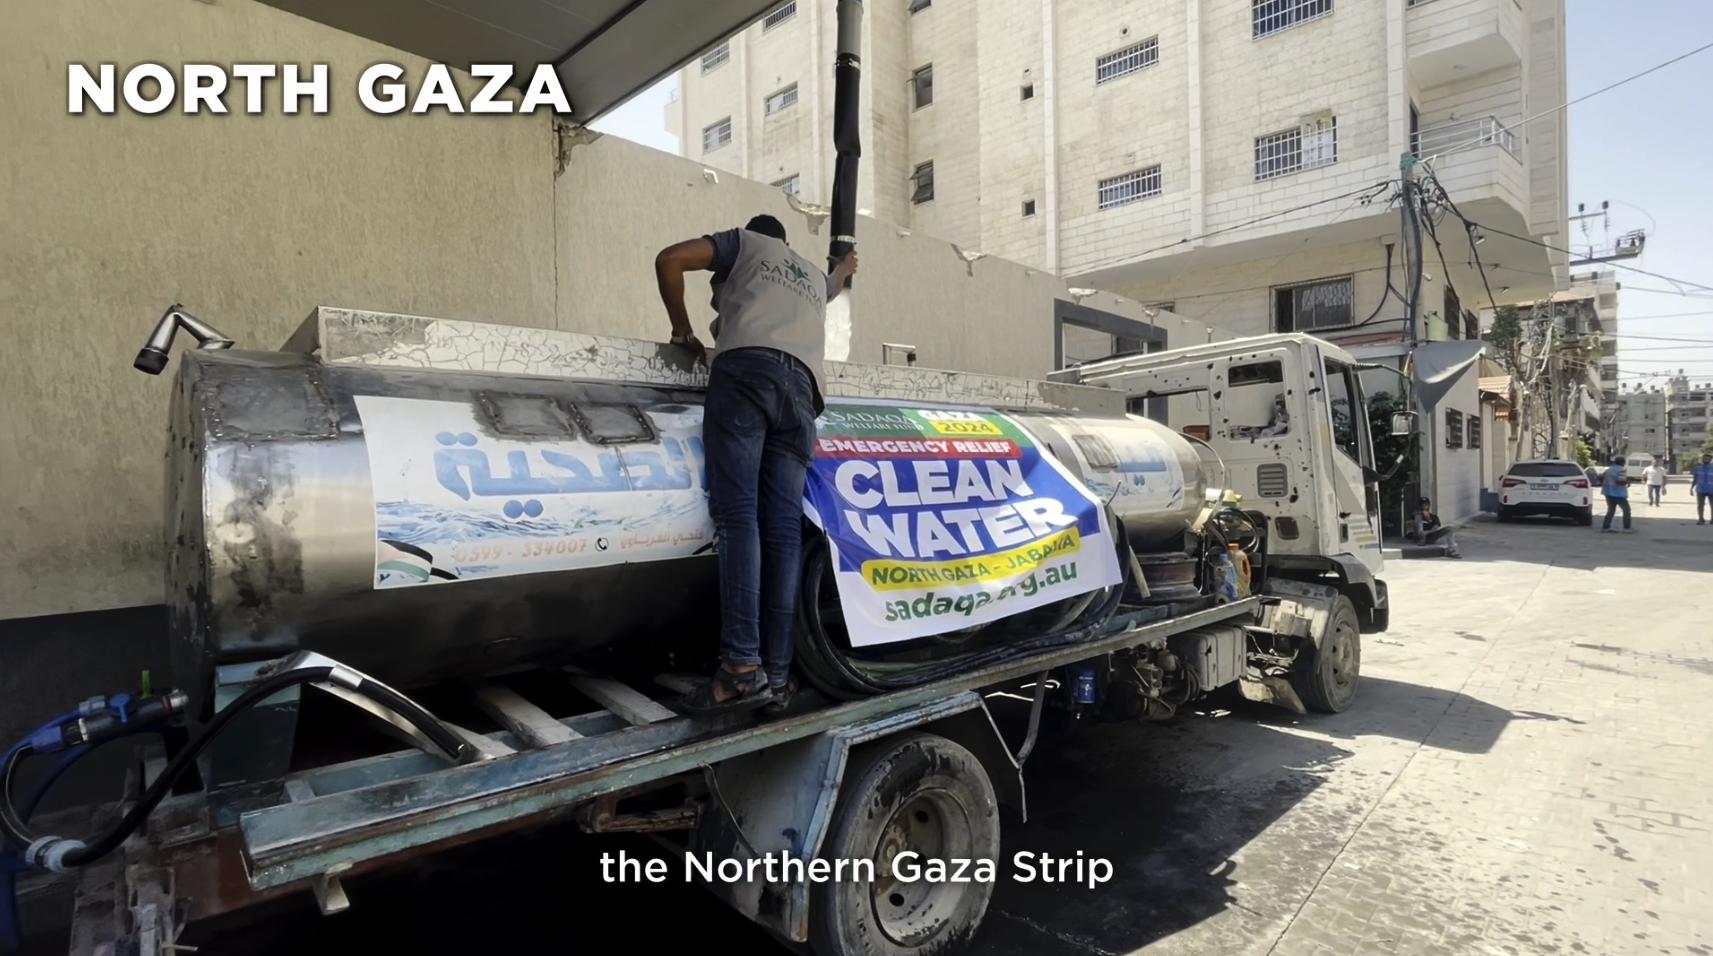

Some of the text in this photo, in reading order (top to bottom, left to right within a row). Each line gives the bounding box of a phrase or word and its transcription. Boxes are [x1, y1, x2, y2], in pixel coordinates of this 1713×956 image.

[831, 411, 917, 424] SADAQA
[917, 410, 988, 422] GAZA
[842, 422, 893, 430] WELFARE
[939, 422, 993, 433] 2024
[818, 438, 1012, 454] EMERGENCY RELIEF
[834, 459, 1034, 509] CLEAN
[843, 497, 1078, 558] WATER
[871, 566, 943, 585] NORTH
[943, 562, 992, 582] GAZA
